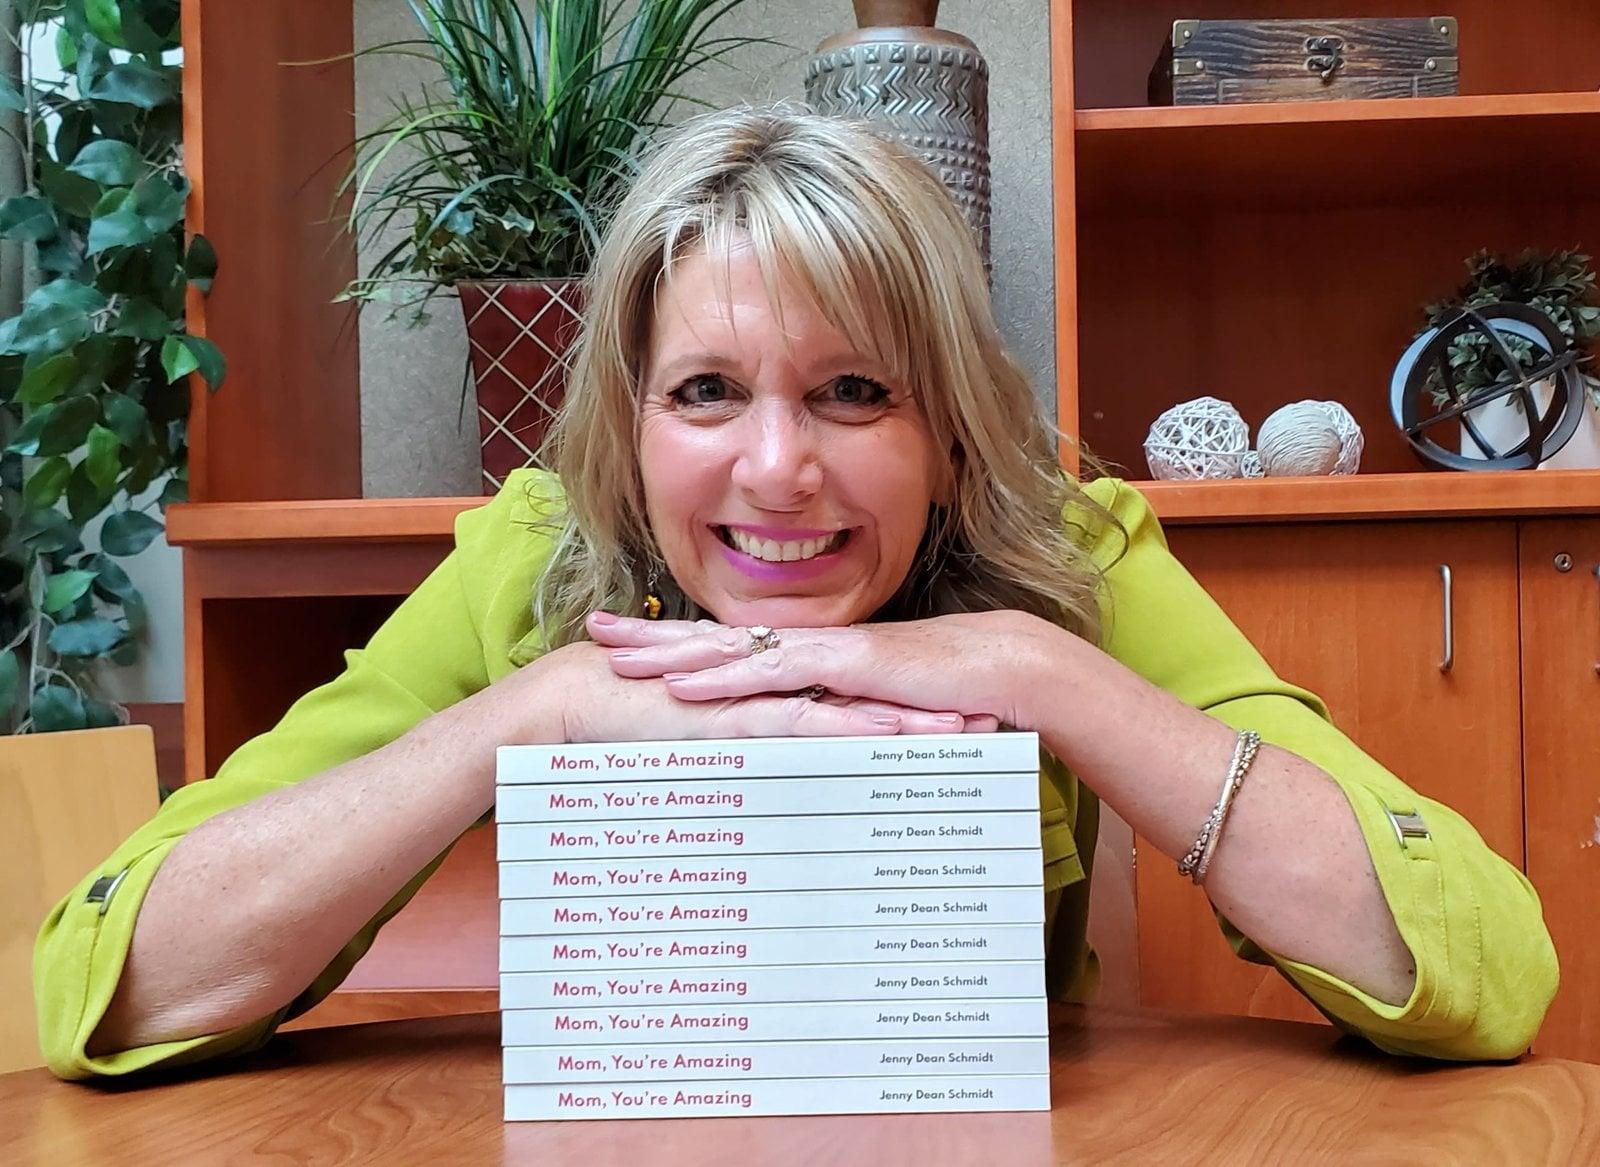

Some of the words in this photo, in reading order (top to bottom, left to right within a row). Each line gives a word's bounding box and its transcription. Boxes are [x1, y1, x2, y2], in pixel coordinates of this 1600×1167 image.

[550, 754, 600, 772] Mom,
[604, 752, 662, 769] You're
[665, 751, 744, 770] Amazing
[869, 749, 904, 763] Jenny
[906, 749, 936, 760] Dean
[938, 747, 984, 760] Schmidt
[549, 793, 599, 810] Mom,
[602, 791, 660, 808] You're
[664, 789, 743, 809] Amazing
[869, 788, 903, 802] Jenny
[905, 788, 935, 799] Dean
[936, 786, 983, 799] Schmidt
[549, 831, 599, 848] Mom,
[603, 828, 661, 846] You're
[664, 828, 744, 846] Amazing
[869, 826, 904, 840] Jenny
[906, 826, 936, 837] Dean
[937, 825, 984, 837] Schmidt
[552, 870, 602, 888] Mom,
[606, 868, 664, 885] You're
[668, 867, 748, 886] Amazing
[873, 866, 908, 879] Jenny
[909, 865, 939, 876] Dean
[941, 863, 987, 876] Schmidt
[553, 907, 604, 925] Mom,
[606, 905, 665, 922] You're
[669, 904, 748, 923] Amazing
[874, 903, 909, 917] Jenny
[910, 902, 941, 914] Dean
[942, 901, 988, 913] Schmidt
[552, 944, 602, 961] Mom,
[606, 941, 664, 959] You're
[667, 940, 747, 959] Amazing
[873, 939, 908, 953] Jenny
[910, 938, 940, 950] Dean
[941, 936, 988, 949] Schmidt
[553, 981, 603, 999] Mom,
[606, 978, 664, 996] You're
[668, 977, 748, 997] Amazing
[874, 976, 908, 991] Jenny
[910, 976, 941, 988] Dean
[942, 974, 989, 987] Schmidt
[554, 1015, 604, 1033] Mom,
[607, 1013, 665, 1030] You're
[669, 1012, 749, 1032] Amazing
[875, 1012, 910, 1026] Jenny
[912, 1011, 942, 1023] Dean
[944, 1010, 990, 1023] Schmidt
[558, 1055, 607, 1073] Mom,
[610, 1053, 669, 1070] You're
[672, 1053, 752, 1072] Amazing
[879, 1053, 914, 1066] Jenny
[915, 1052, 946, 1064] Dean
[947, 1051, 994, 1063] Schmidt
[557, 1092, 607, 1110] Mom,
[611, 1090, 669, 1107] You're
[672, 1089, 752, 1109] Amazing
[879, 1089, 914, 1103] Jenny
[915, 1089, 946, 1100] Dean
[947, 1088, 994, 1100] Schmidt
